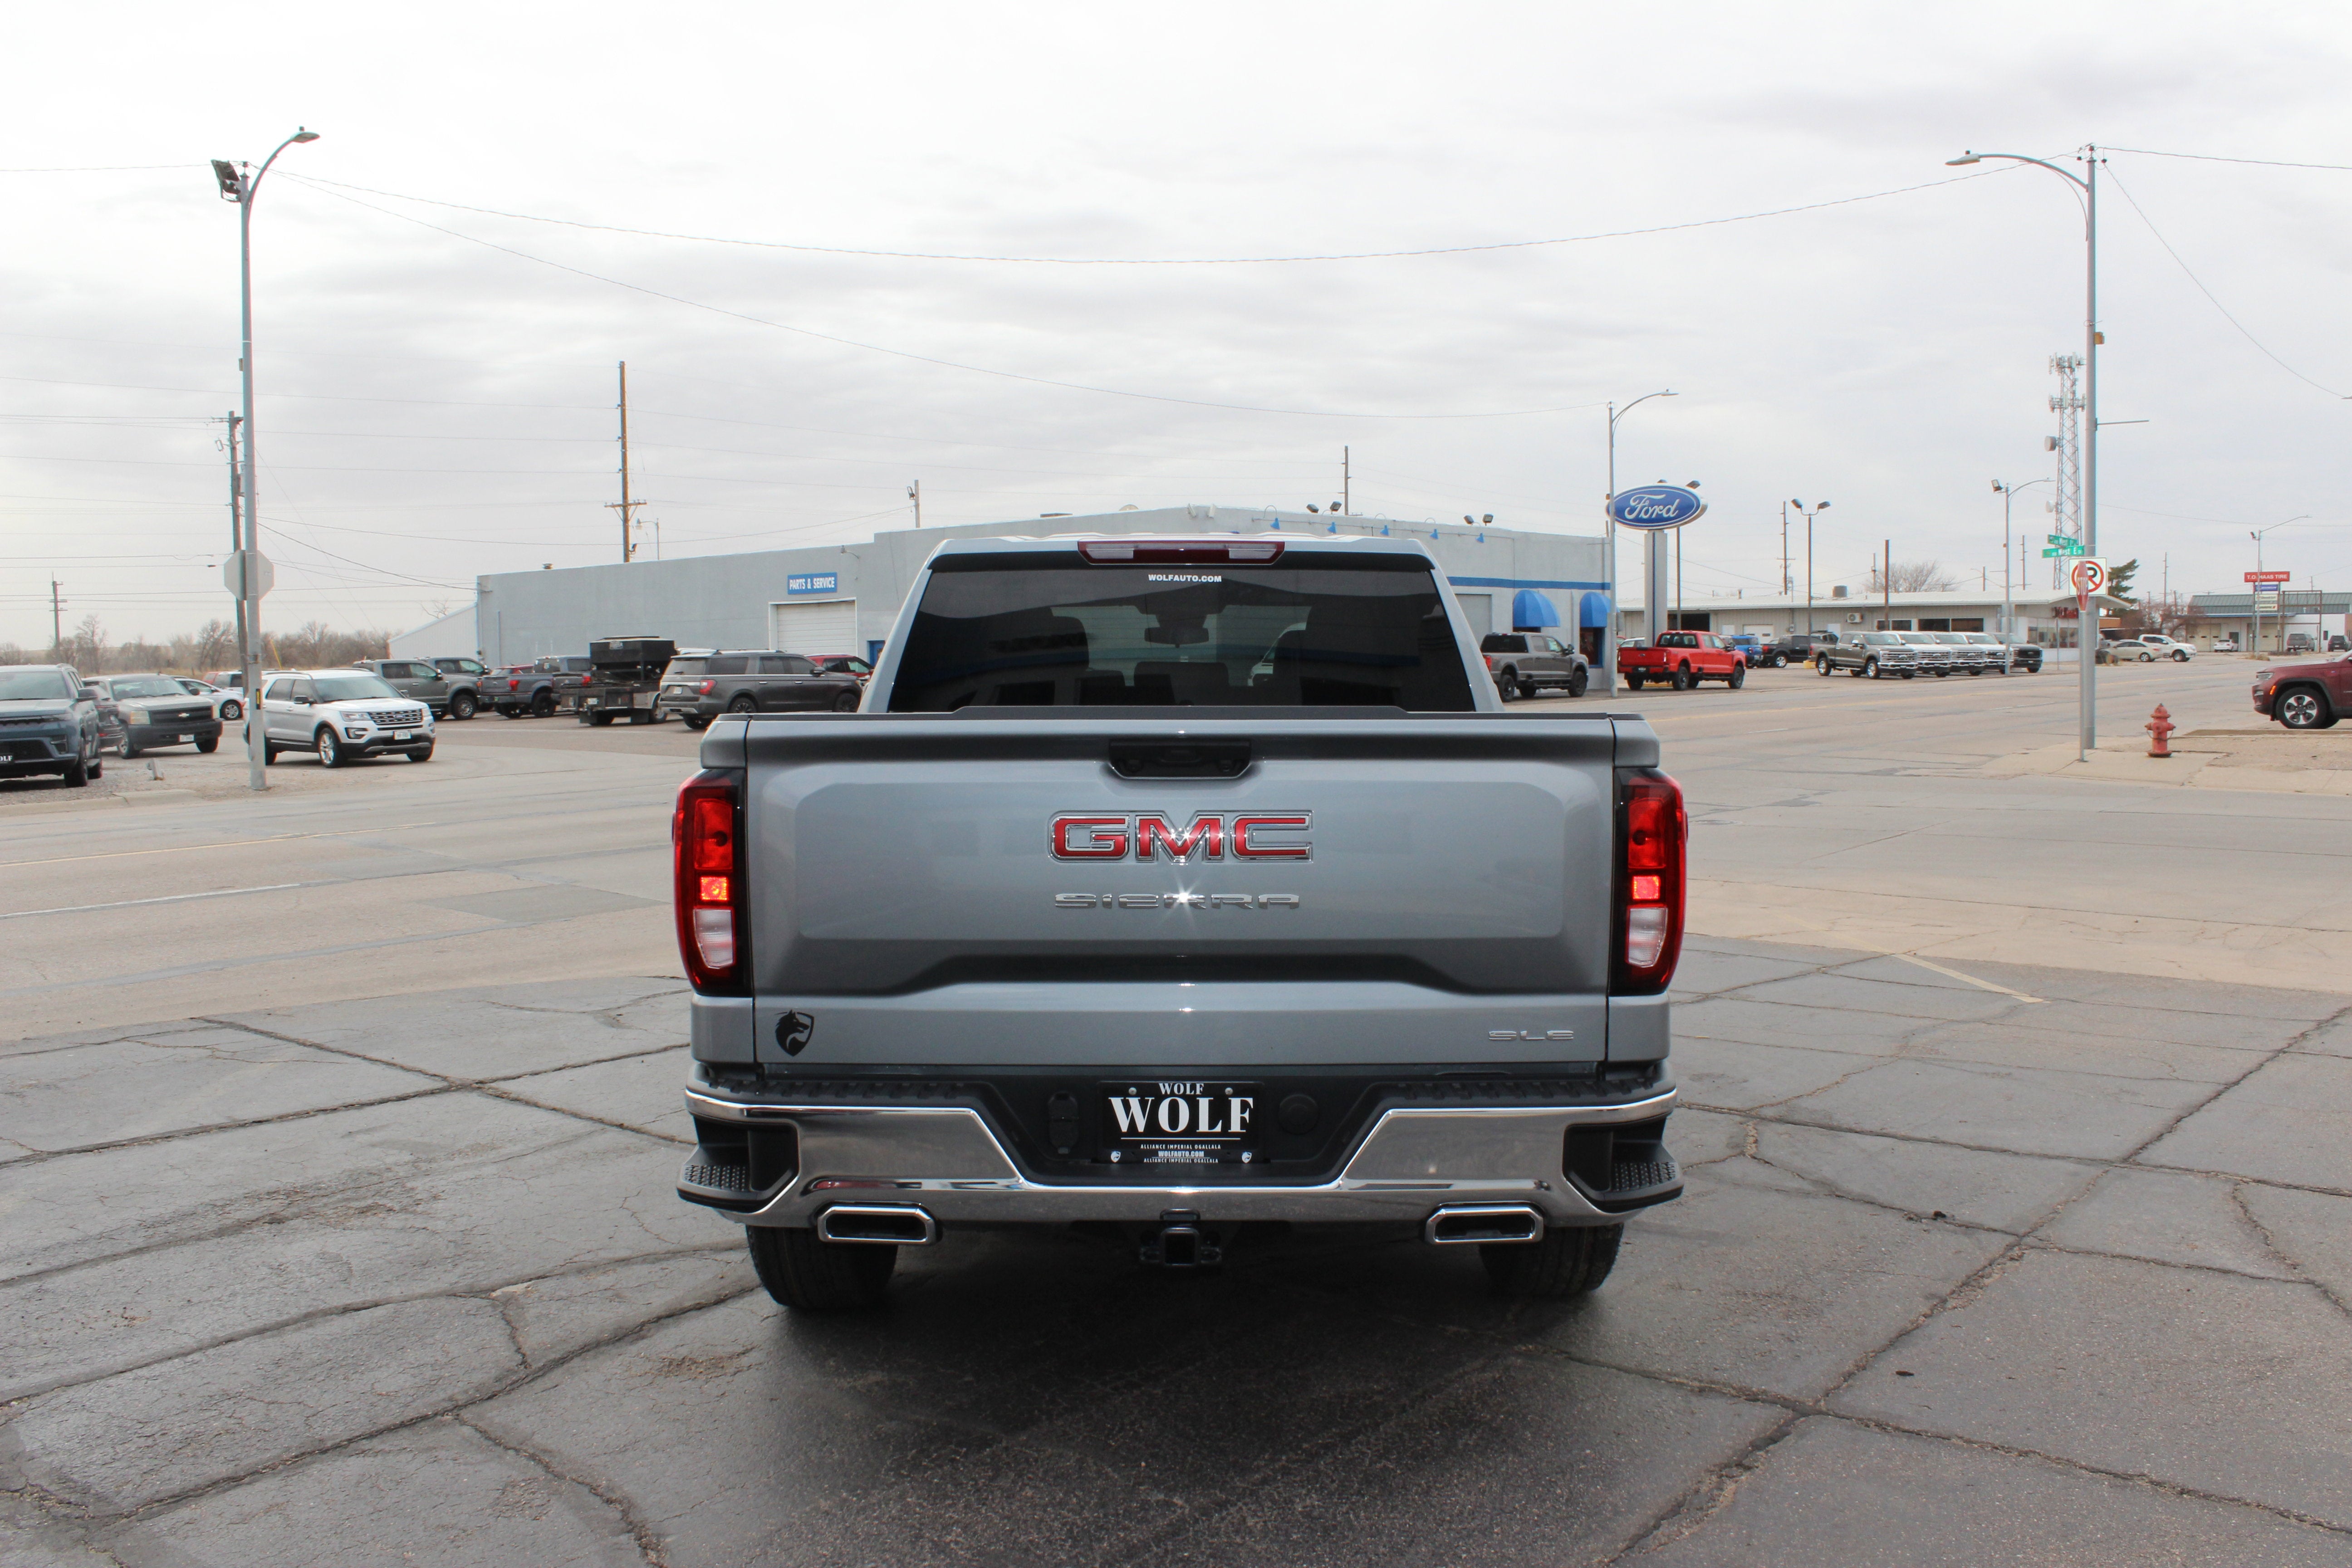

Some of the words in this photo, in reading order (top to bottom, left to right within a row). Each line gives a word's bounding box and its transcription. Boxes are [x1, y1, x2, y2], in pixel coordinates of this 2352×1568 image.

[1625, 494, 1680, 519] Ford
[789, 578, 806, 590] PARTS
[807, 578, 812, 589] &
[813, 577, 835, 589] SERVICE
[1148, 574, 1222, 582] WOLFAUTO.COM
[2077, 577, 2089, 596] STOP
[1049, 810, 1313, 864] GMC
[1054, 893, 1299, 909] SIERRA
[1489, 1030, 1574, 1041] SLE
[1158, 1083, 1204, 1095] WOLF
[1108, 1097, 1254, 1132] WOLF
